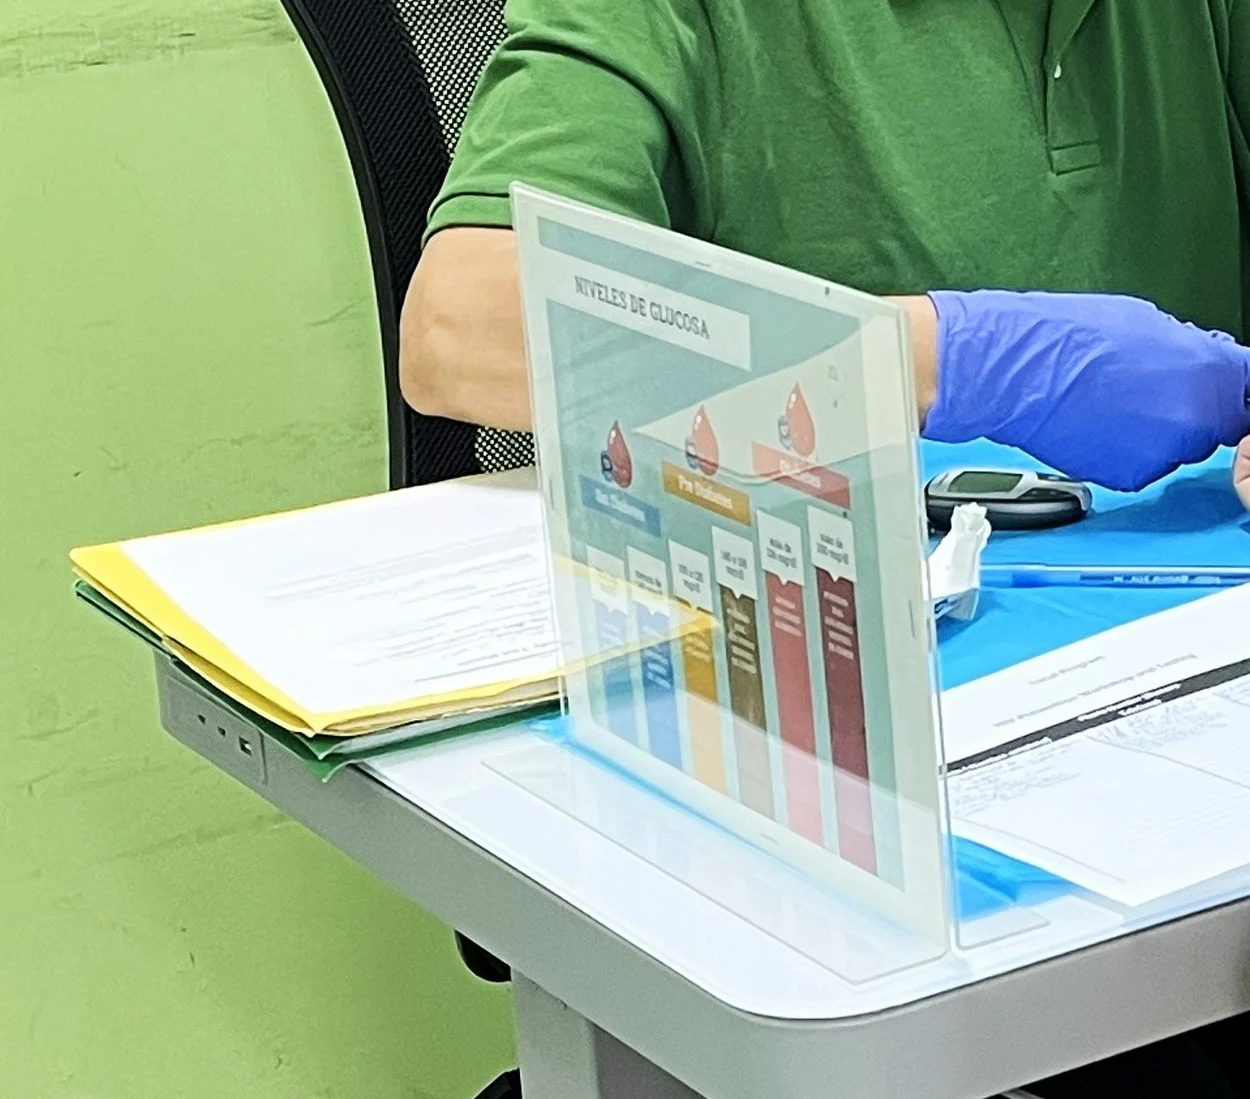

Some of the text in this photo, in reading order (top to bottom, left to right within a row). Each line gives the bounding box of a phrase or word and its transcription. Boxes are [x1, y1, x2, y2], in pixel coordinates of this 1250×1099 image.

[574, 276, 710, 340] NIVELES DE GLUCOSA
